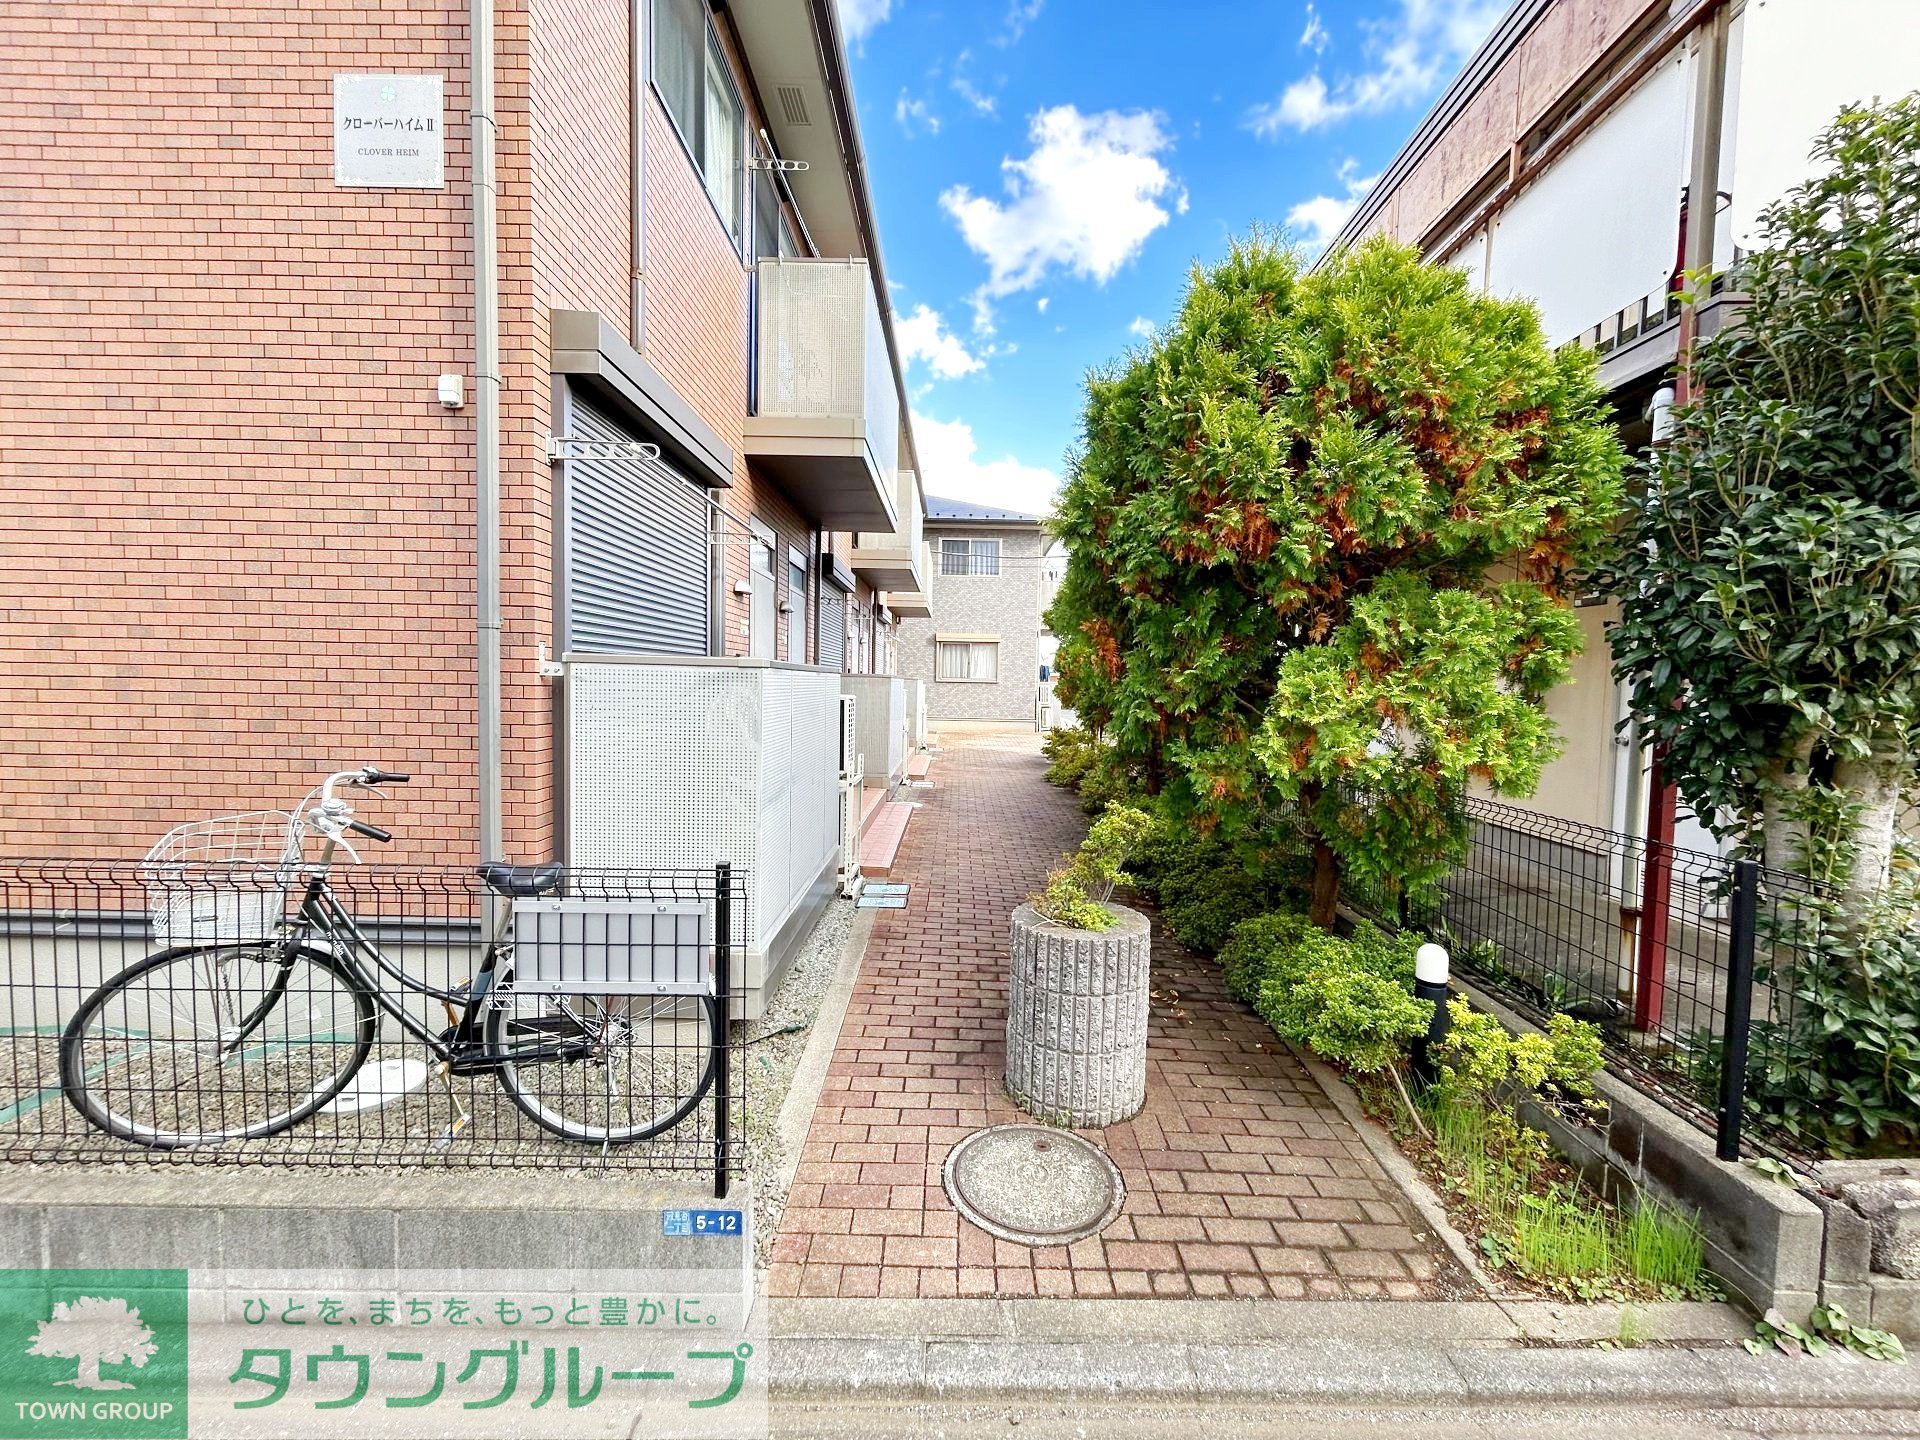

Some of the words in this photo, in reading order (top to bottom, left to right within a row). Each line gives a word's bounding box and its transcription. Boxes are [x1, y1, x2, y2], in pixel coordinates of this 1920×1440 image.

[357, 148, 393, 156] CLOVER
[396, 148, 420, 157] HEIM
[696, 1215, 736, 1230] 5-12
